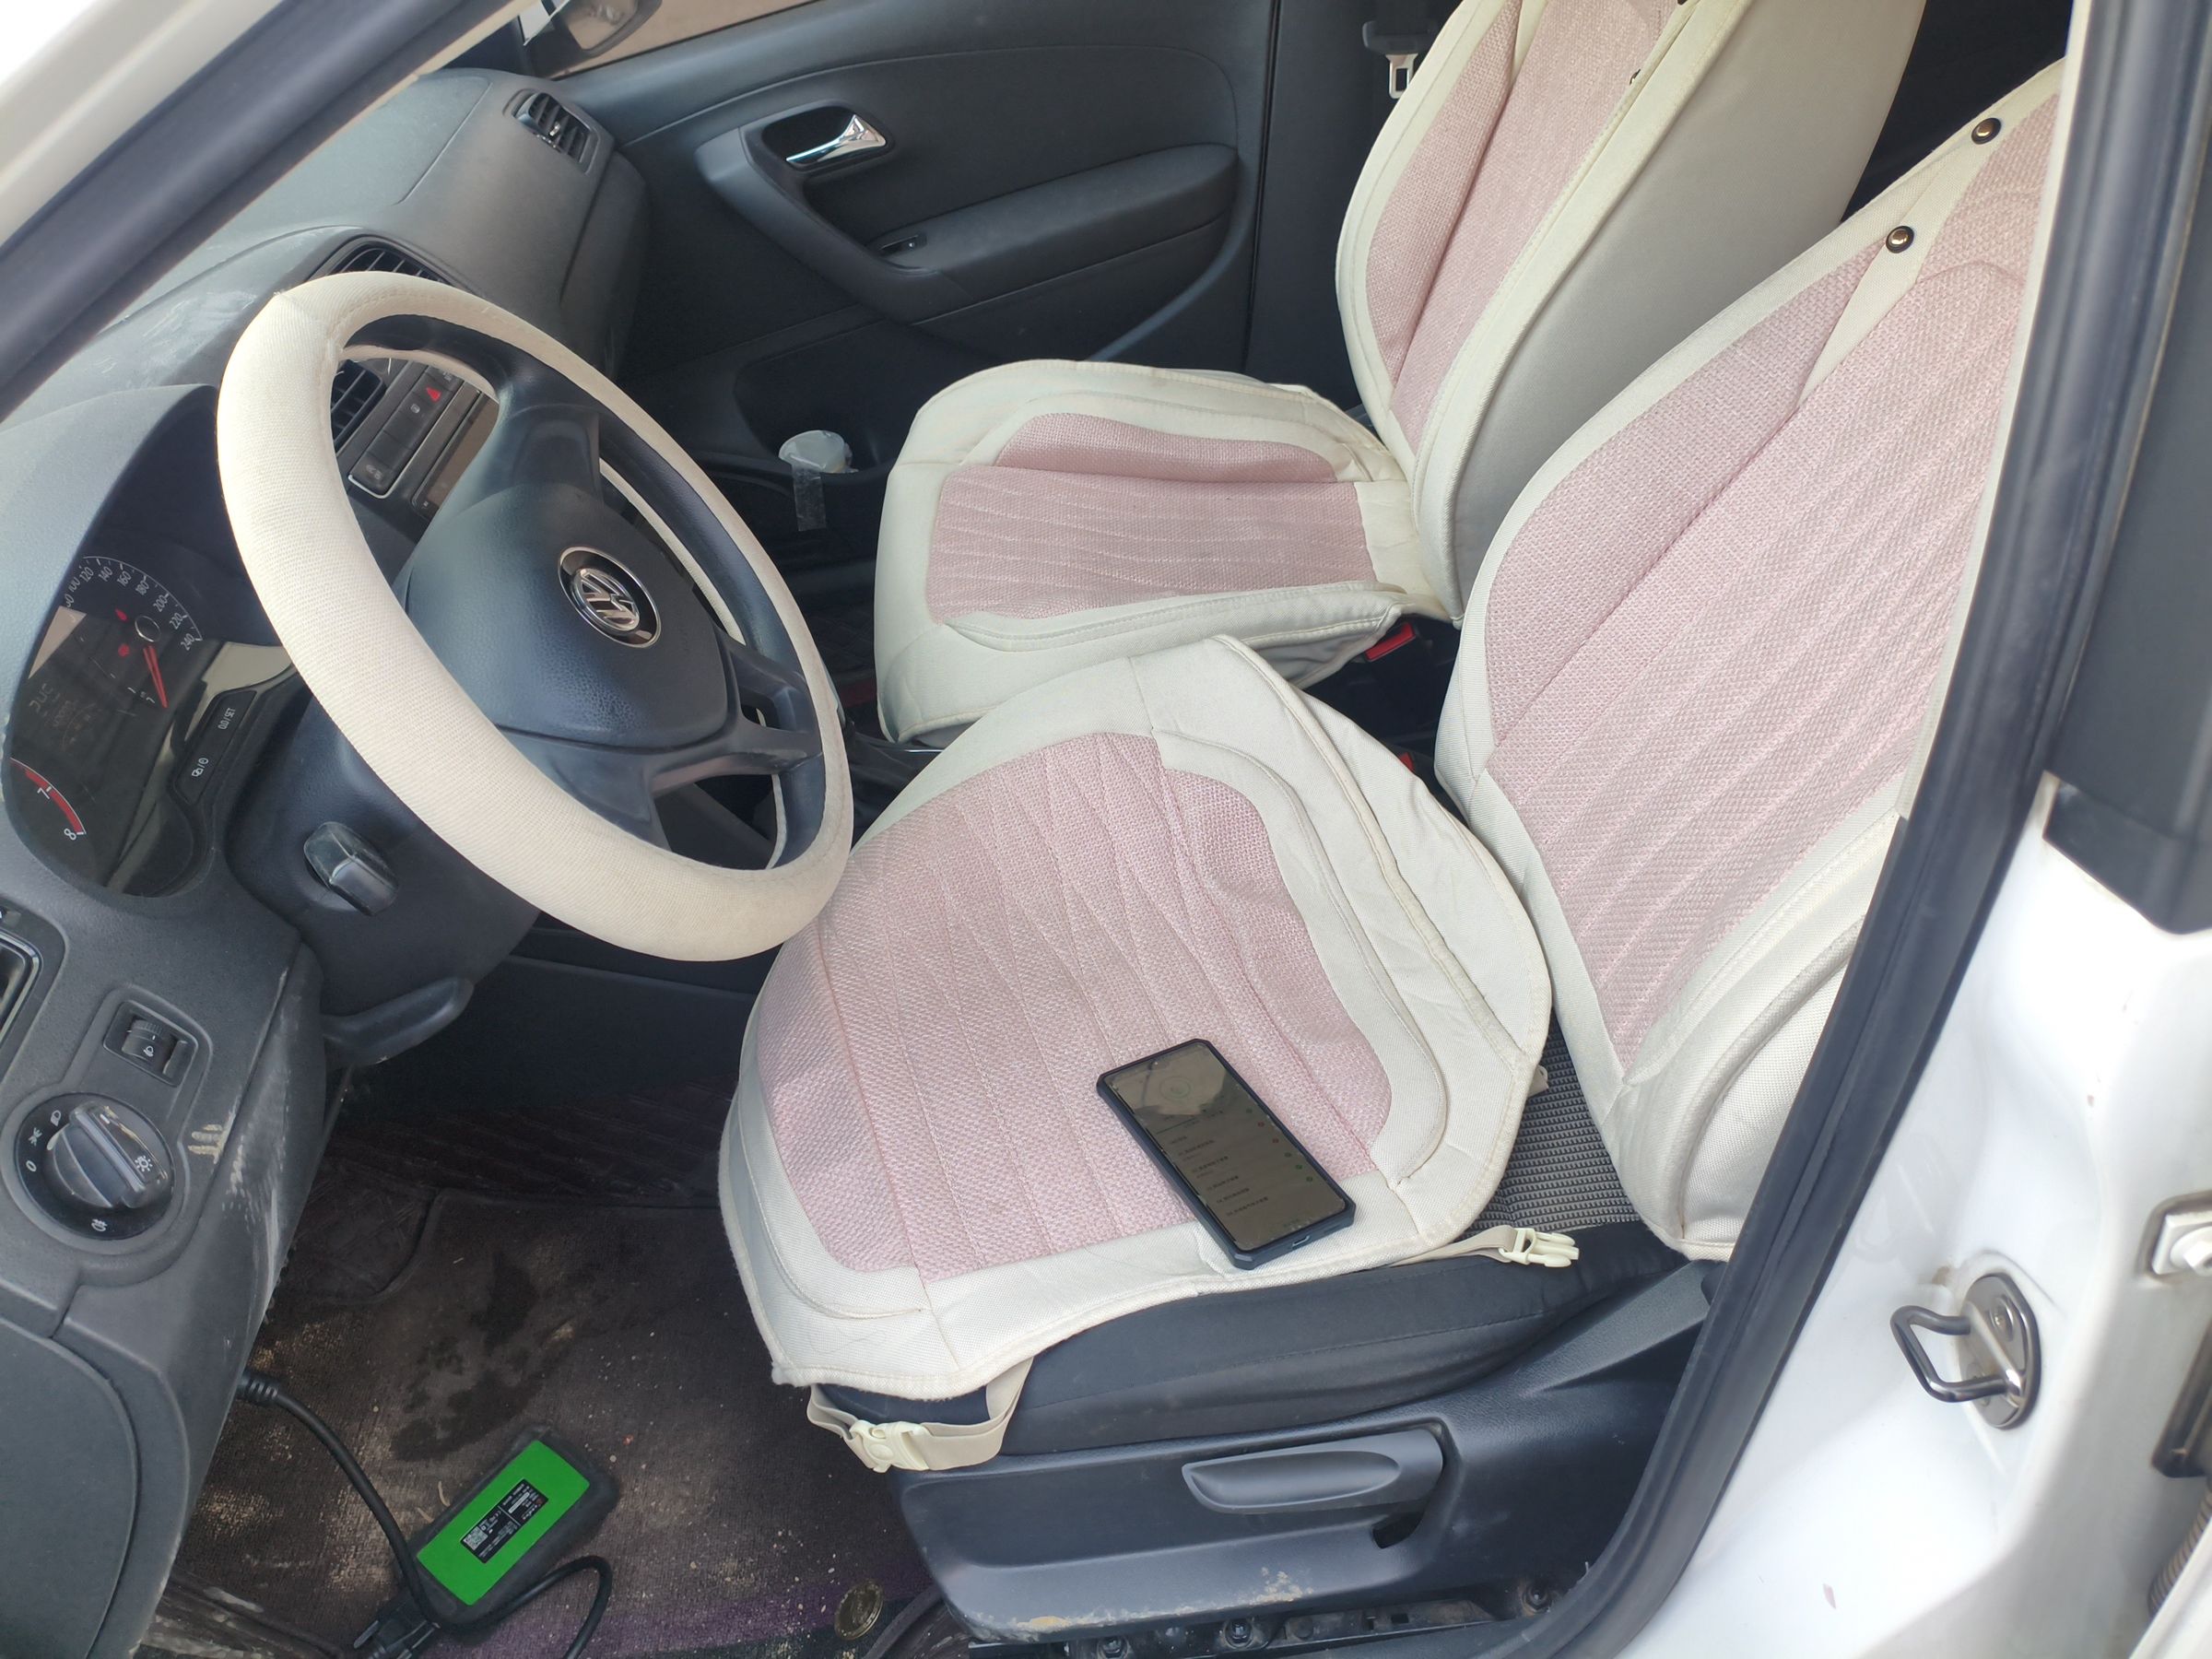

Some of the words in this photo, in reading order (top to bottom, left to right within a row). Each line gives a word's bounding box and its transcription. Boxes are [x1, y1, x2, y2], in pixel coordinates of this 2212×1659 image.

[79, 566, 94, 582] 120
[98, 566, 112, 582] 140
[116, 571, 132, 587] 160
[135, 580, 149, 595] 180
[153, 594, 169, 612] 200
[169, 612, 184, 629] 220
[181, 633, 195, 651] 240
[37, 786, 50, 799] 7
[64, 828, 76, 841] 8
